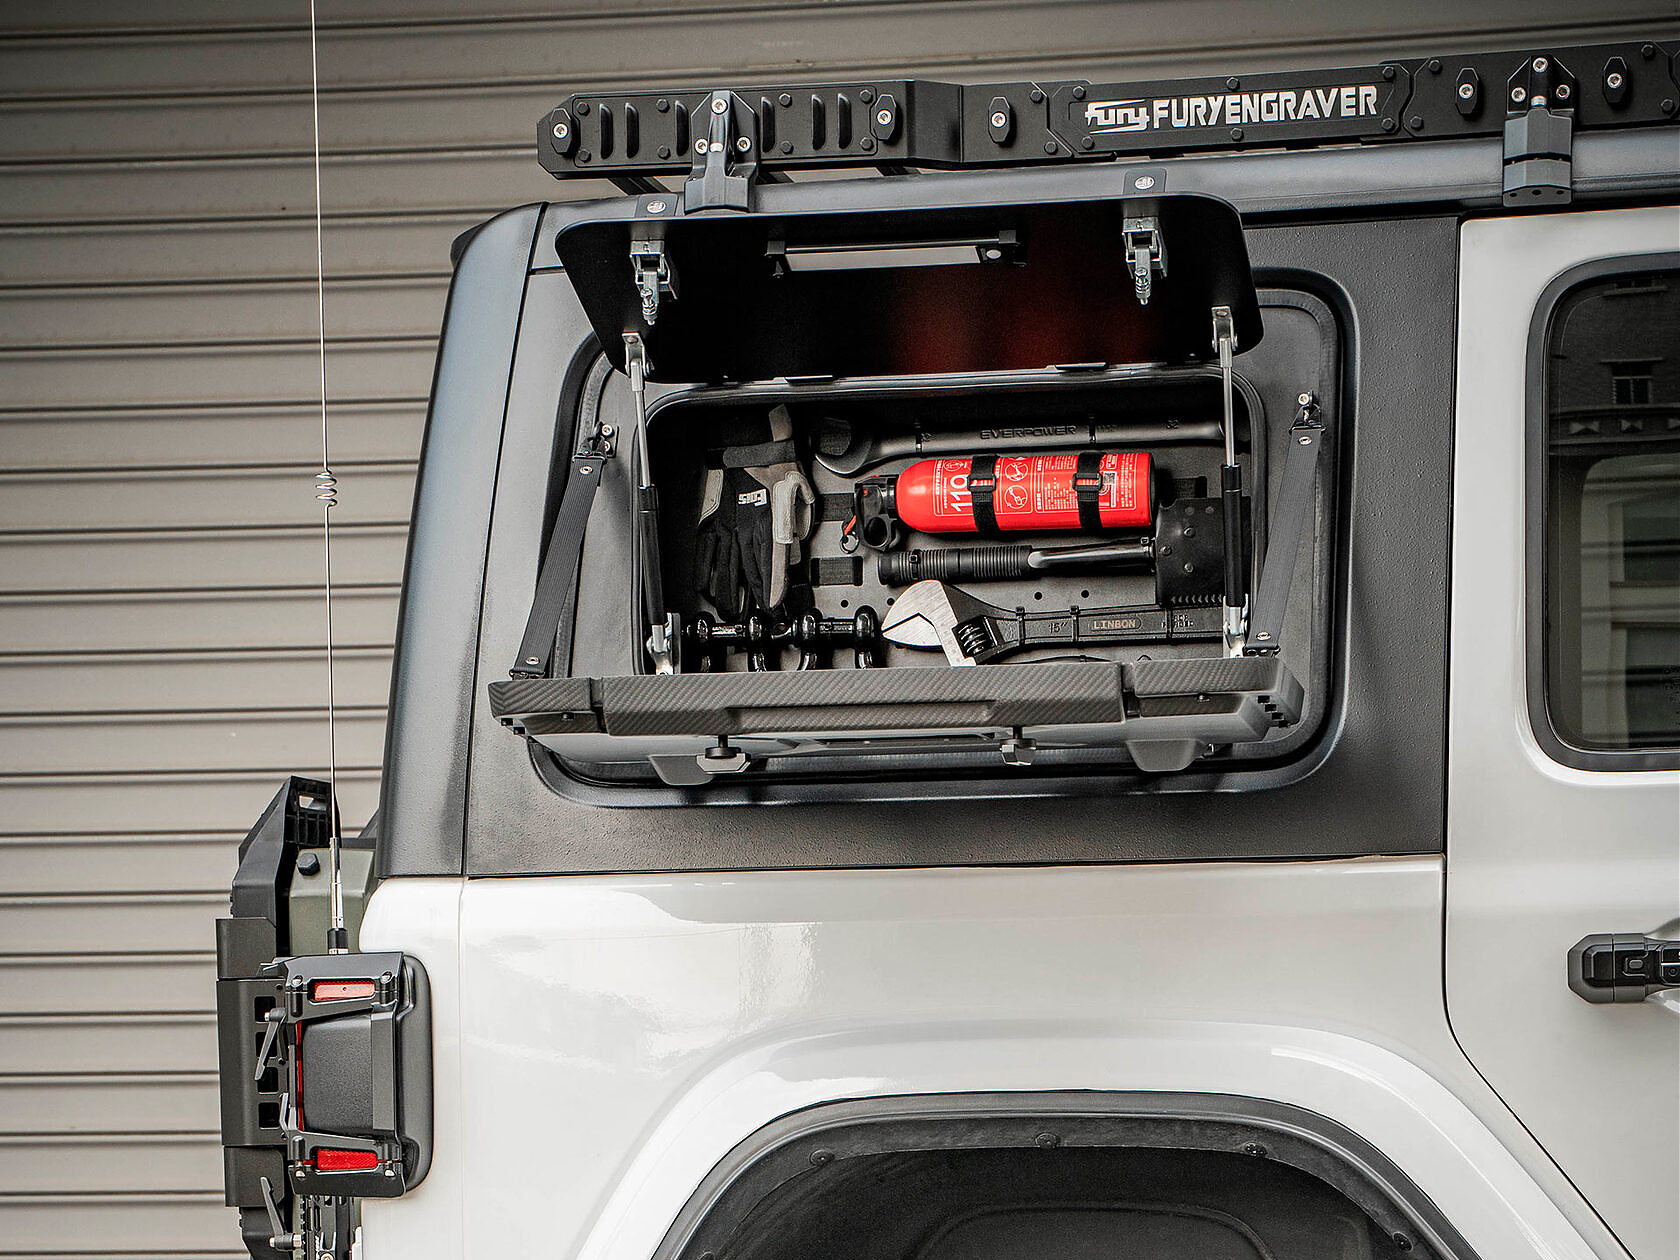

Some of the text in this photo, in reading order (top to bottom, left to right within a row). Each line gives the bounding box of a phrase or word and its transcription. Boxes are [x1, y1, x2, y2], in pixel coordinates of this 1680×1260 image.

[1084, 85, 1378, 135] fury FURYENGRAVER
[980, 425, 1077, 440] EVERPOWER
[1093, 619, 1136, 629] LINBON
